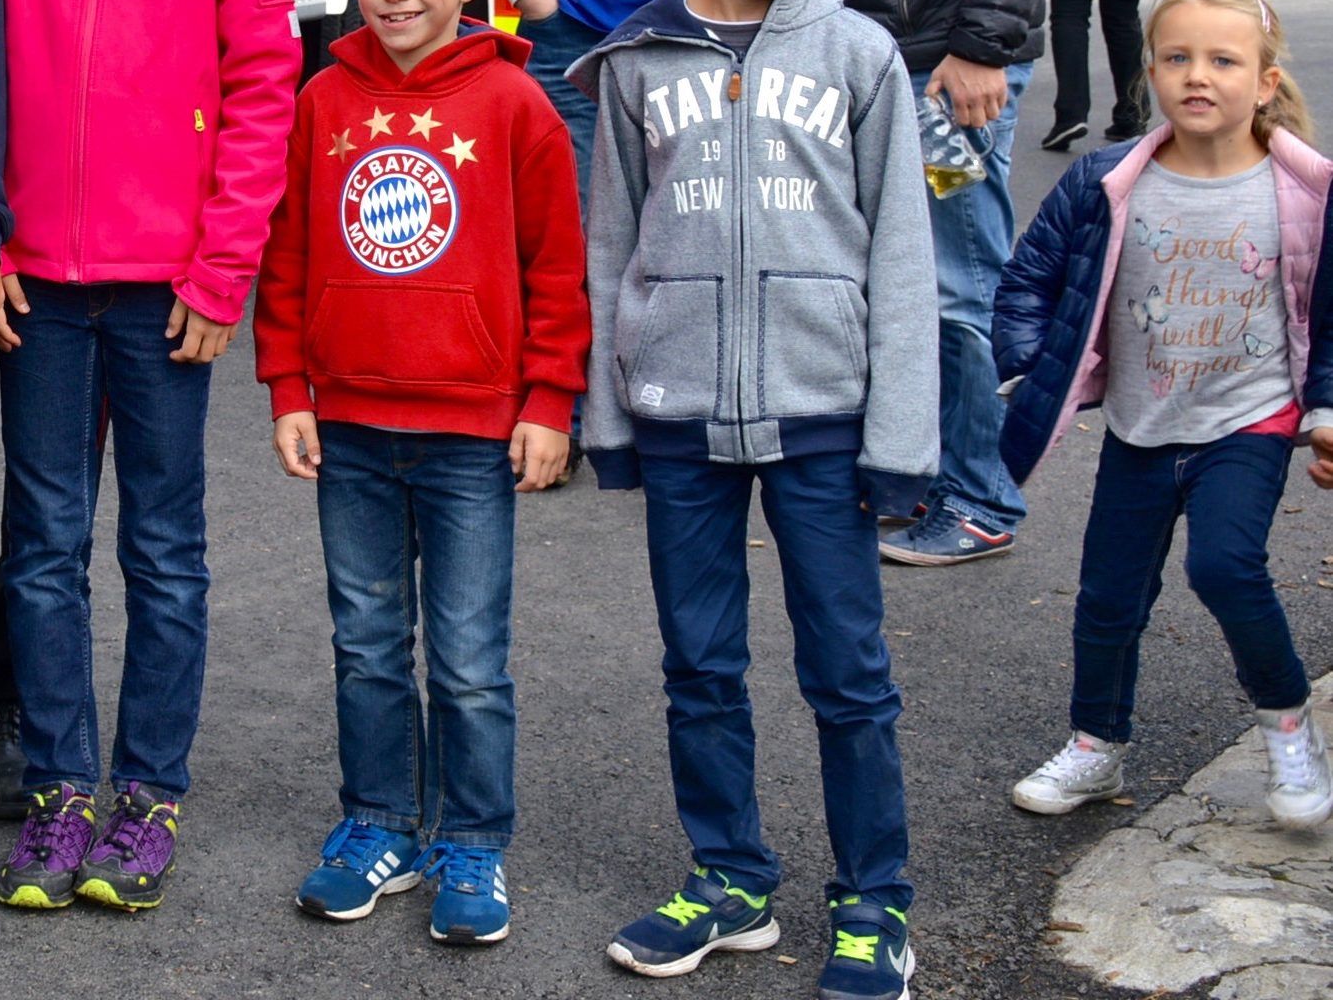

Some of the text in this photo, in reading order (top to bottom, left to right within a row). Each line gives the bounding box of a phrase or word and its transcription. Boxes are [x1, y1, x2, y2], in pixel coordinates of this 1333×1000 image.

[755, 67, 850, 148] REAL
[700, 140, 786, 162] 19 78
[348, 156, 448, 205] FC BAYERN
[673, 177, 818, 214] NEW YORK
[348, 222, 446, 266] MÜNCHEN
[1153, 216, 1248, 264] Good
[1164, 266, 1275, 342] things
[1162, 313, 1226, 347] will
[1146, 333, 1255, 392] happen
